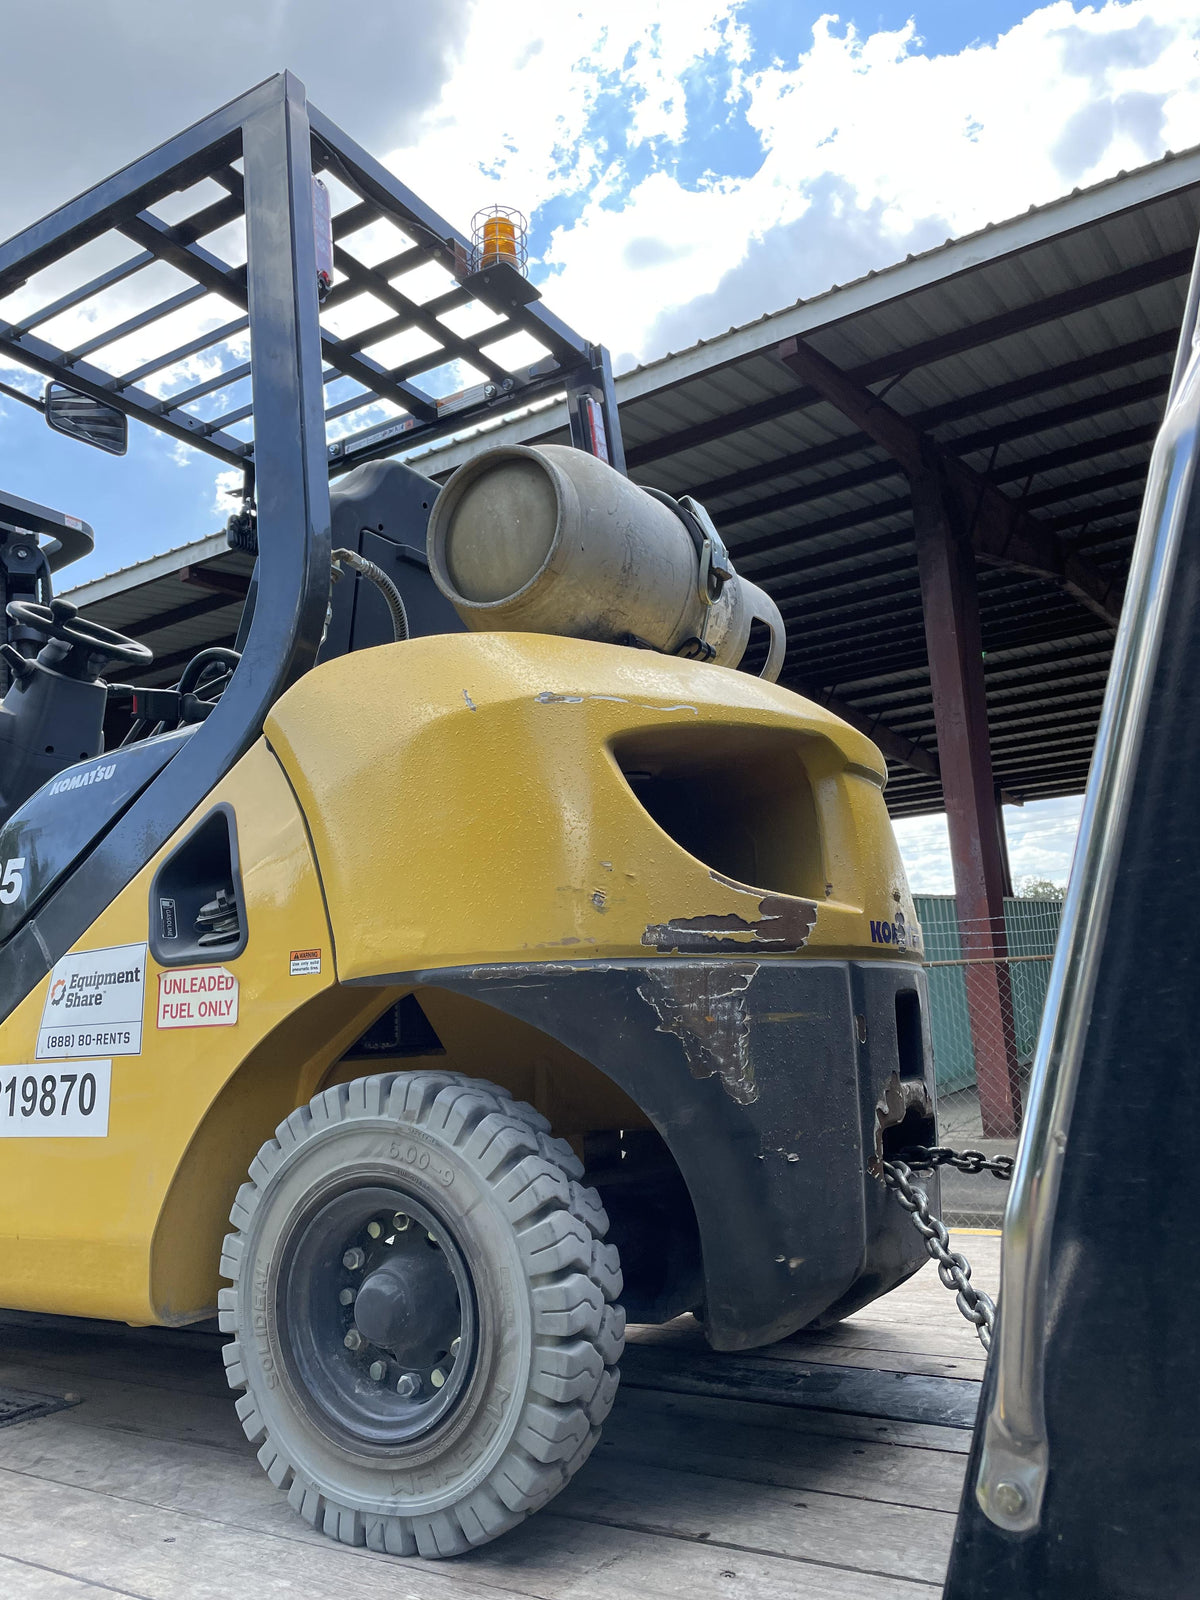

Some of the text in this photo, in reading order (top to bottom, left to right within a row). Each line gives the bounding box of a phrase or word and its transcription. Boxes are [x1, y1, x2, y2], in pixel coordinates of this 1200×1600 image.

[49, 764, 117, 796] KOMATSU
[0, 857, 26, 905] 5
[69, 967, 140, 992] Equipment
[164, 975, 234, 995] UNLEADED
[65, 992, 103, 1008] Share
[162, 999, 234, 1020] FUEL ONLY
[47, 1032, 131, 1049] (888) 80-RENTS
[0, 1072, 96, 1117] 19870
